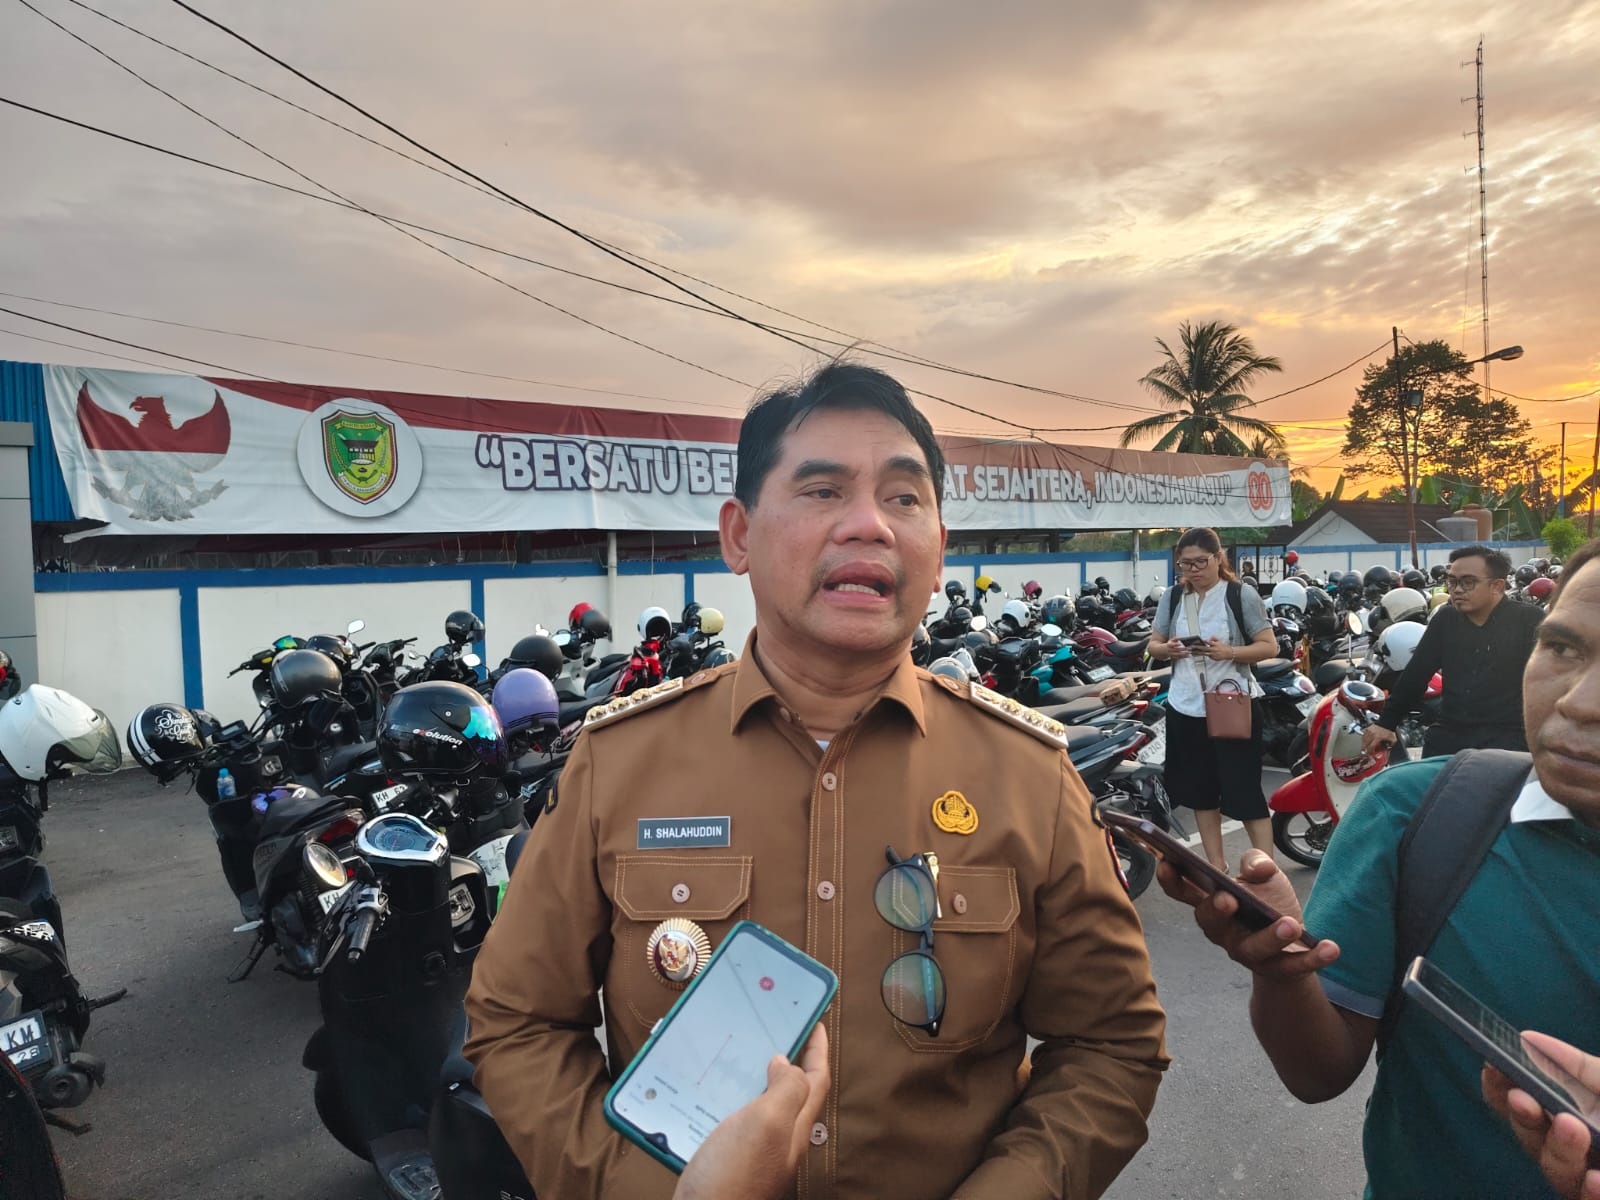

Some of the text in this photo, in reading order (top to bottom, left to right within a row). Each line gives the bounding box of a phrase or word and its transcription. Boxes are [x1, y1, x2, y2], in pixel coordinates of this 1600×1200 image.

[973, 465, 1092, 509] SEJAHTERA,
[1094, 471, 1183, 505] INDONESIA
[1248, 471, 1273, 511] 80
[375, 791, 388, 803] KH
[643, 825, 723, 840] H. SHALAHUDDIN
[323, 891, 340, 908] KH
[6, 1023, 35, 1049] KM
